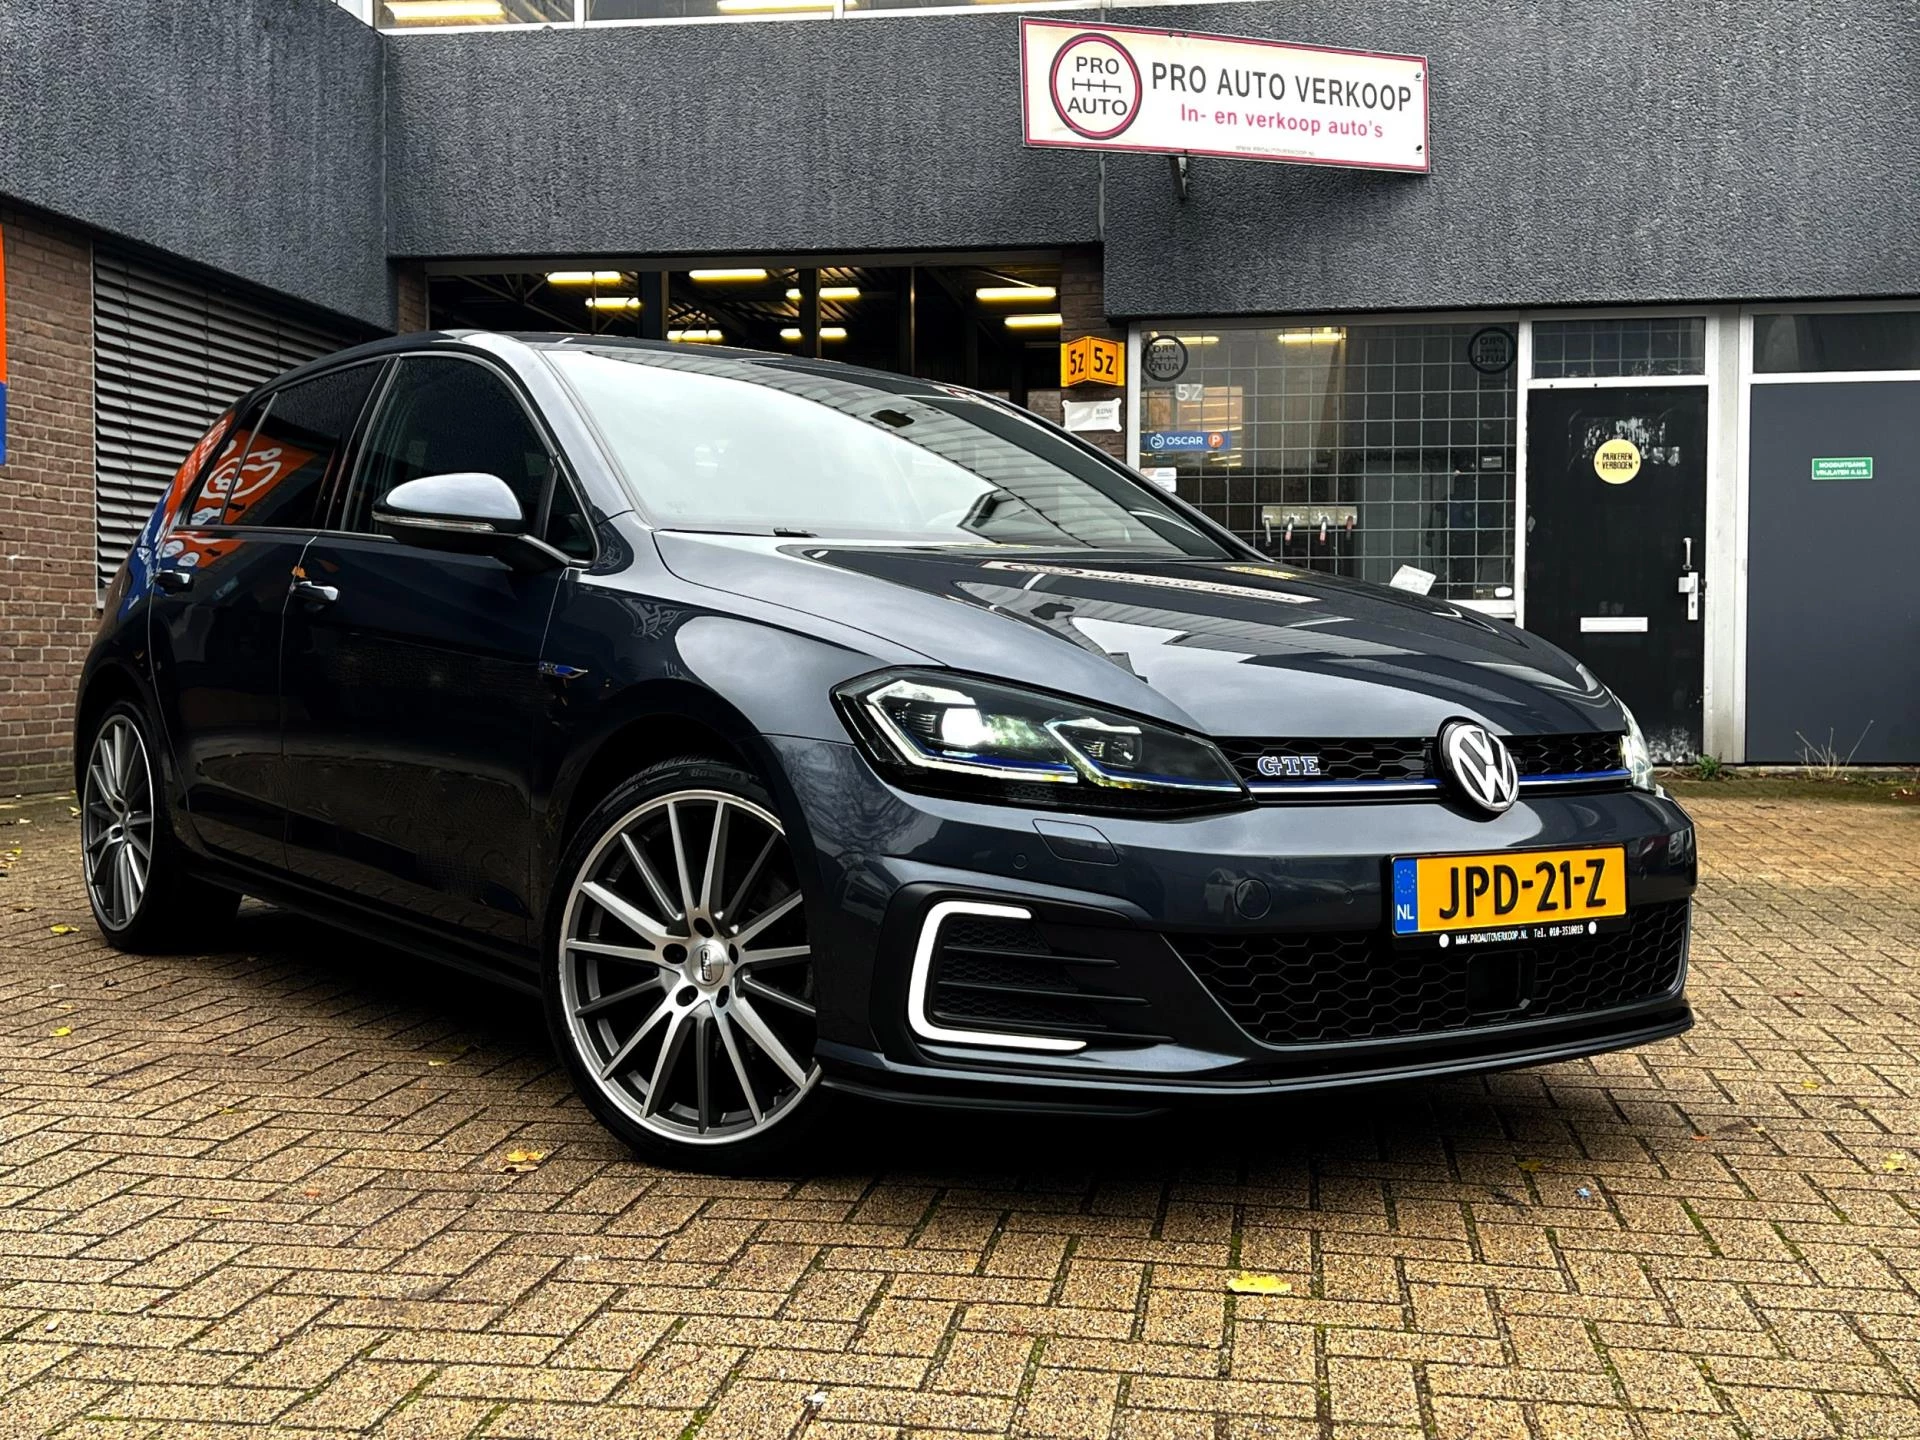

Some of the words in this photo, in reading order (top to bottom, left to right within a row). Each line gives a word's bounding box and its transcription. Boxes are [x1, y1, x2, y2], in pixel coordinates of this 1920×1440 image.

[1076, 56, 1120, 75] PRO
[1152, 62, 1206, 94] PRO
[1217, 68, 1286, 101] AUTO
[1295, 75, 1412, 112] VERKOOP
[1067, 97, 1128, 116] AUTO
[1181, 103, 1207, 123] In-
[1215, 110, 1238, 125] en
[1245, 112, 1321, 137] verkoop
[1328, 120, 1384, 138] auto's
[1166, 436, 1204, 446] OSCAR
[1602, 461, 1633, 469] VERBODEN
[1257, 756, 1321, 776] GTE
[1439, 858, 1607, 919] JPD-21-Z
[1396, 904, 1415, 920] NL
[1534, 927, 1547, 938] Tel.
